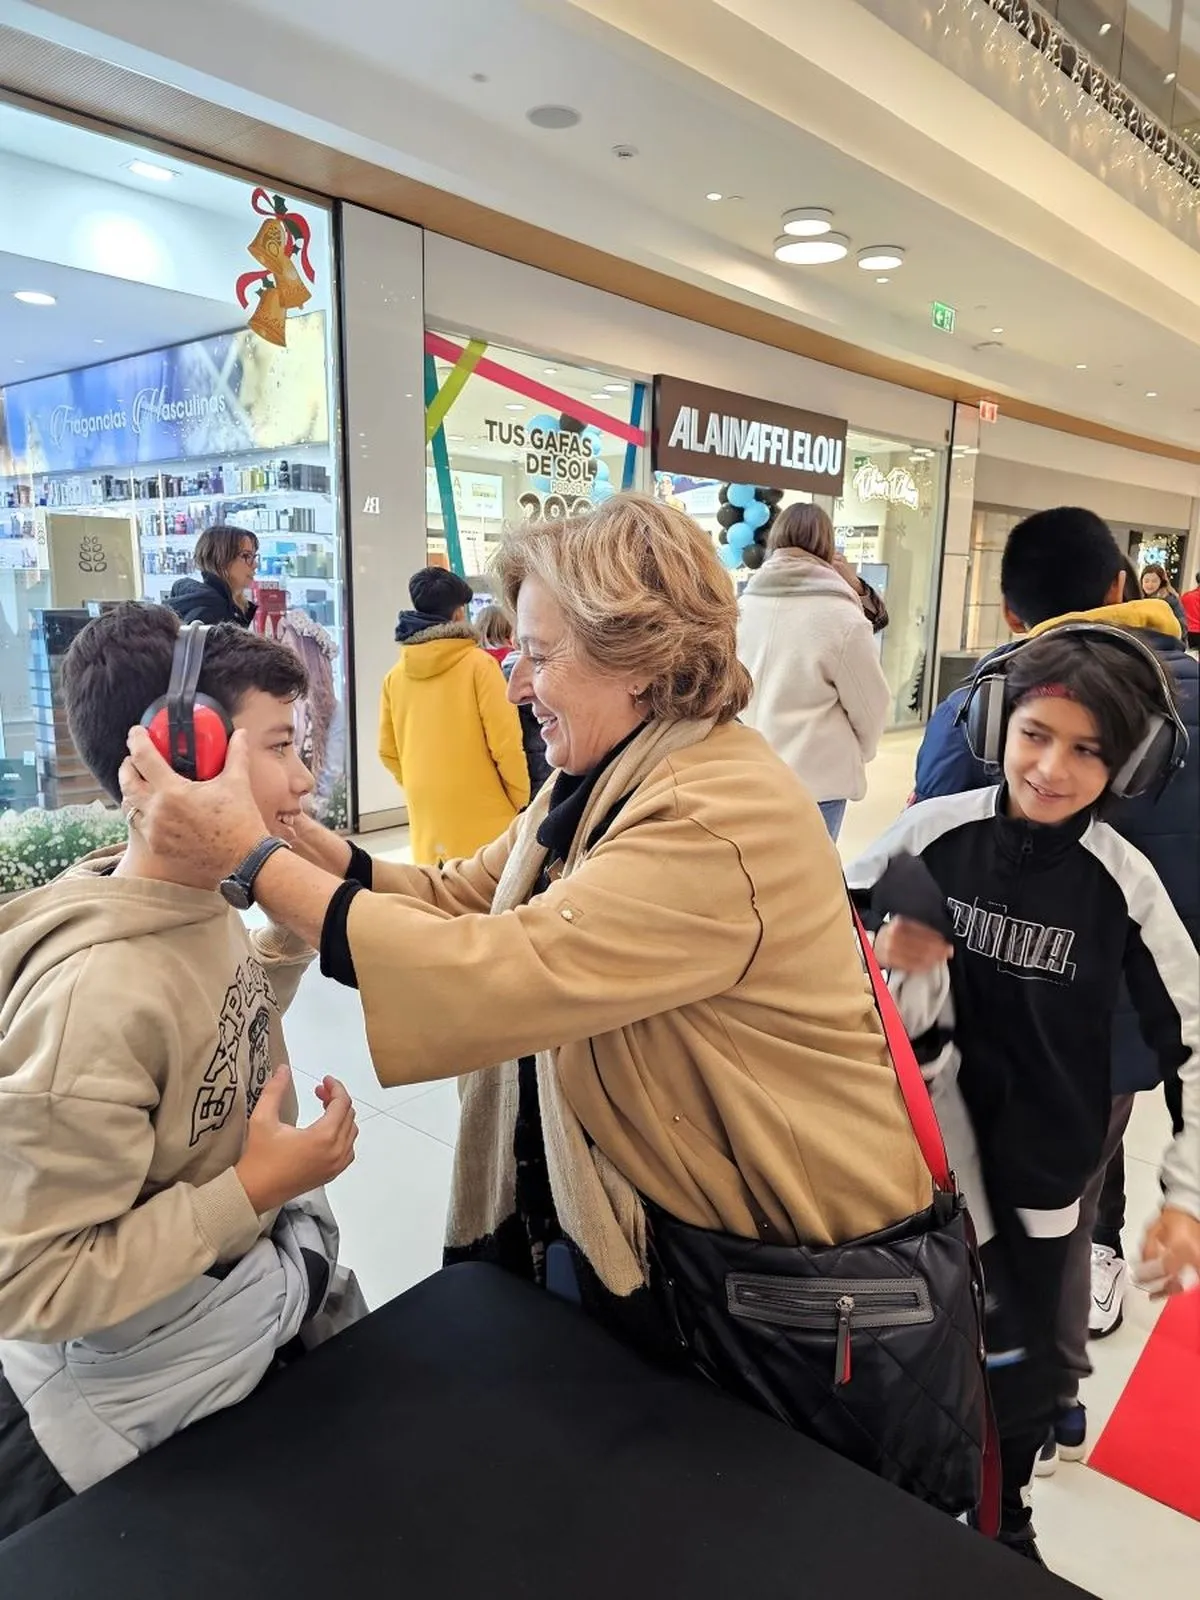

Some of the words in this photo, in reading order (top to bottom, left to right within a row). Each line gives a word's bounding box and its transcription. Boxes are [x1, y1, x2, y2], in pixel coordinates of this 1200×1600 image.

[51, 404, 127, 448] Fragancias
[131, 384, 226, 434] Masculinas
[484, 419, 525, 447] TUS
[530, 427, 592, 458] GAFAS
[526, 453, 551, 476] DE
[556, 457, 593, 483] SOL
